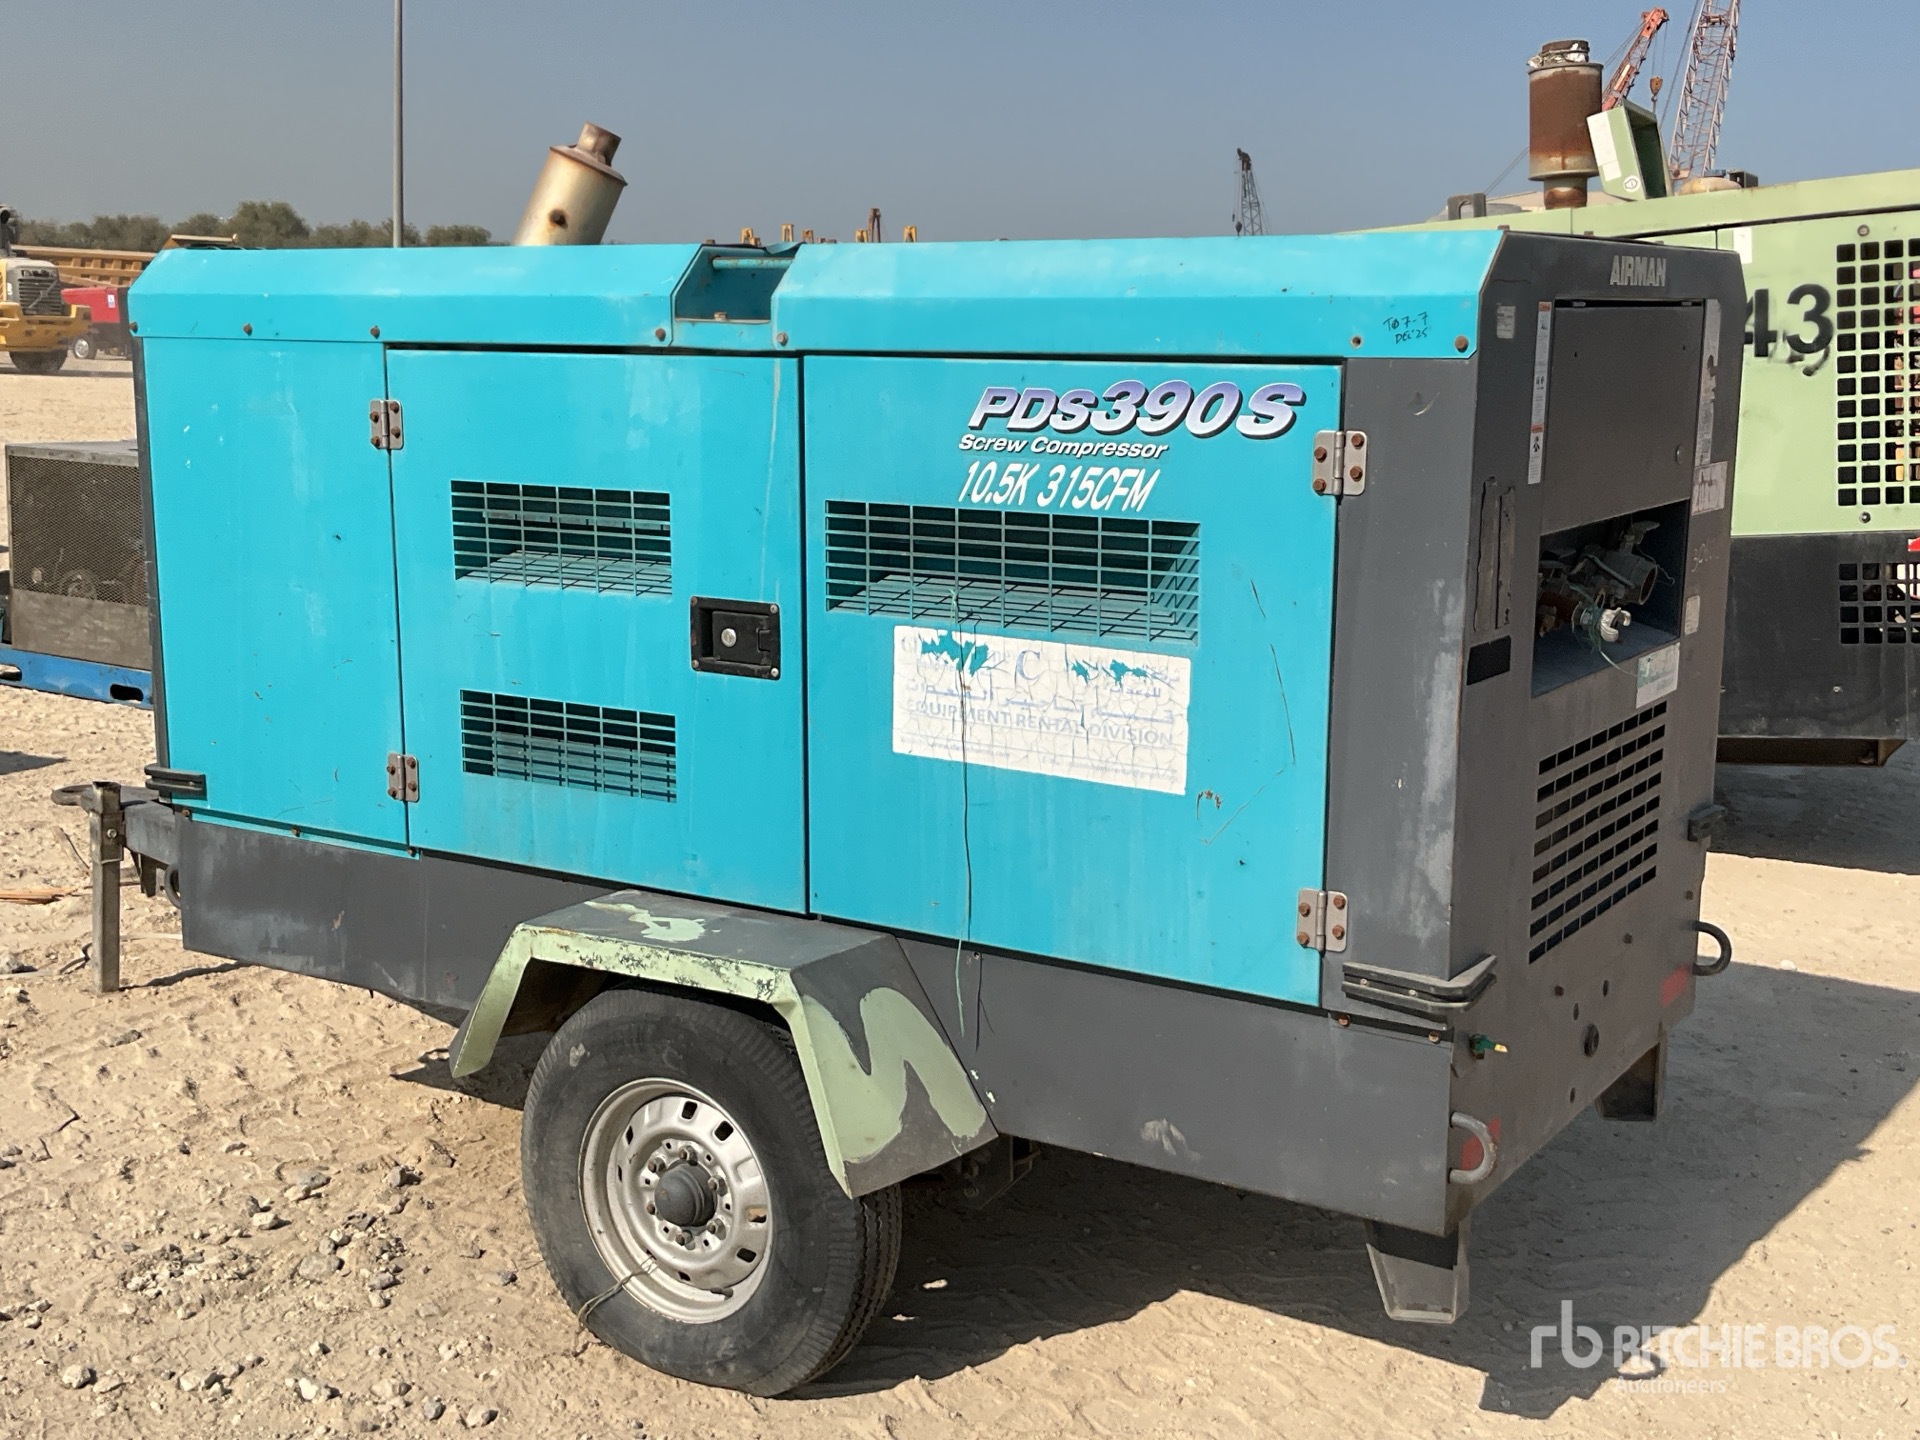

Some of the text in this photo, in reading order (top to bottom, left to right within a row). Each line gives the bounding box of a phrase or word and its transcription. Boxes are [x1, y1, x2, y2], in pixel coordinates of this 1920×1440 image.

[1609, 255, 1667, 288] AIRMAN
[1744, 283, 1834, 358] 43
[968, 380, 1306, 440] PDS390S
[958, 433, 1169, 460] Screw Compressor
[958, 461, 1161, 513] 10.5K 315CFM
[907, 700, 1173, 745] EQUIPMENT RENTAL DIVISION
